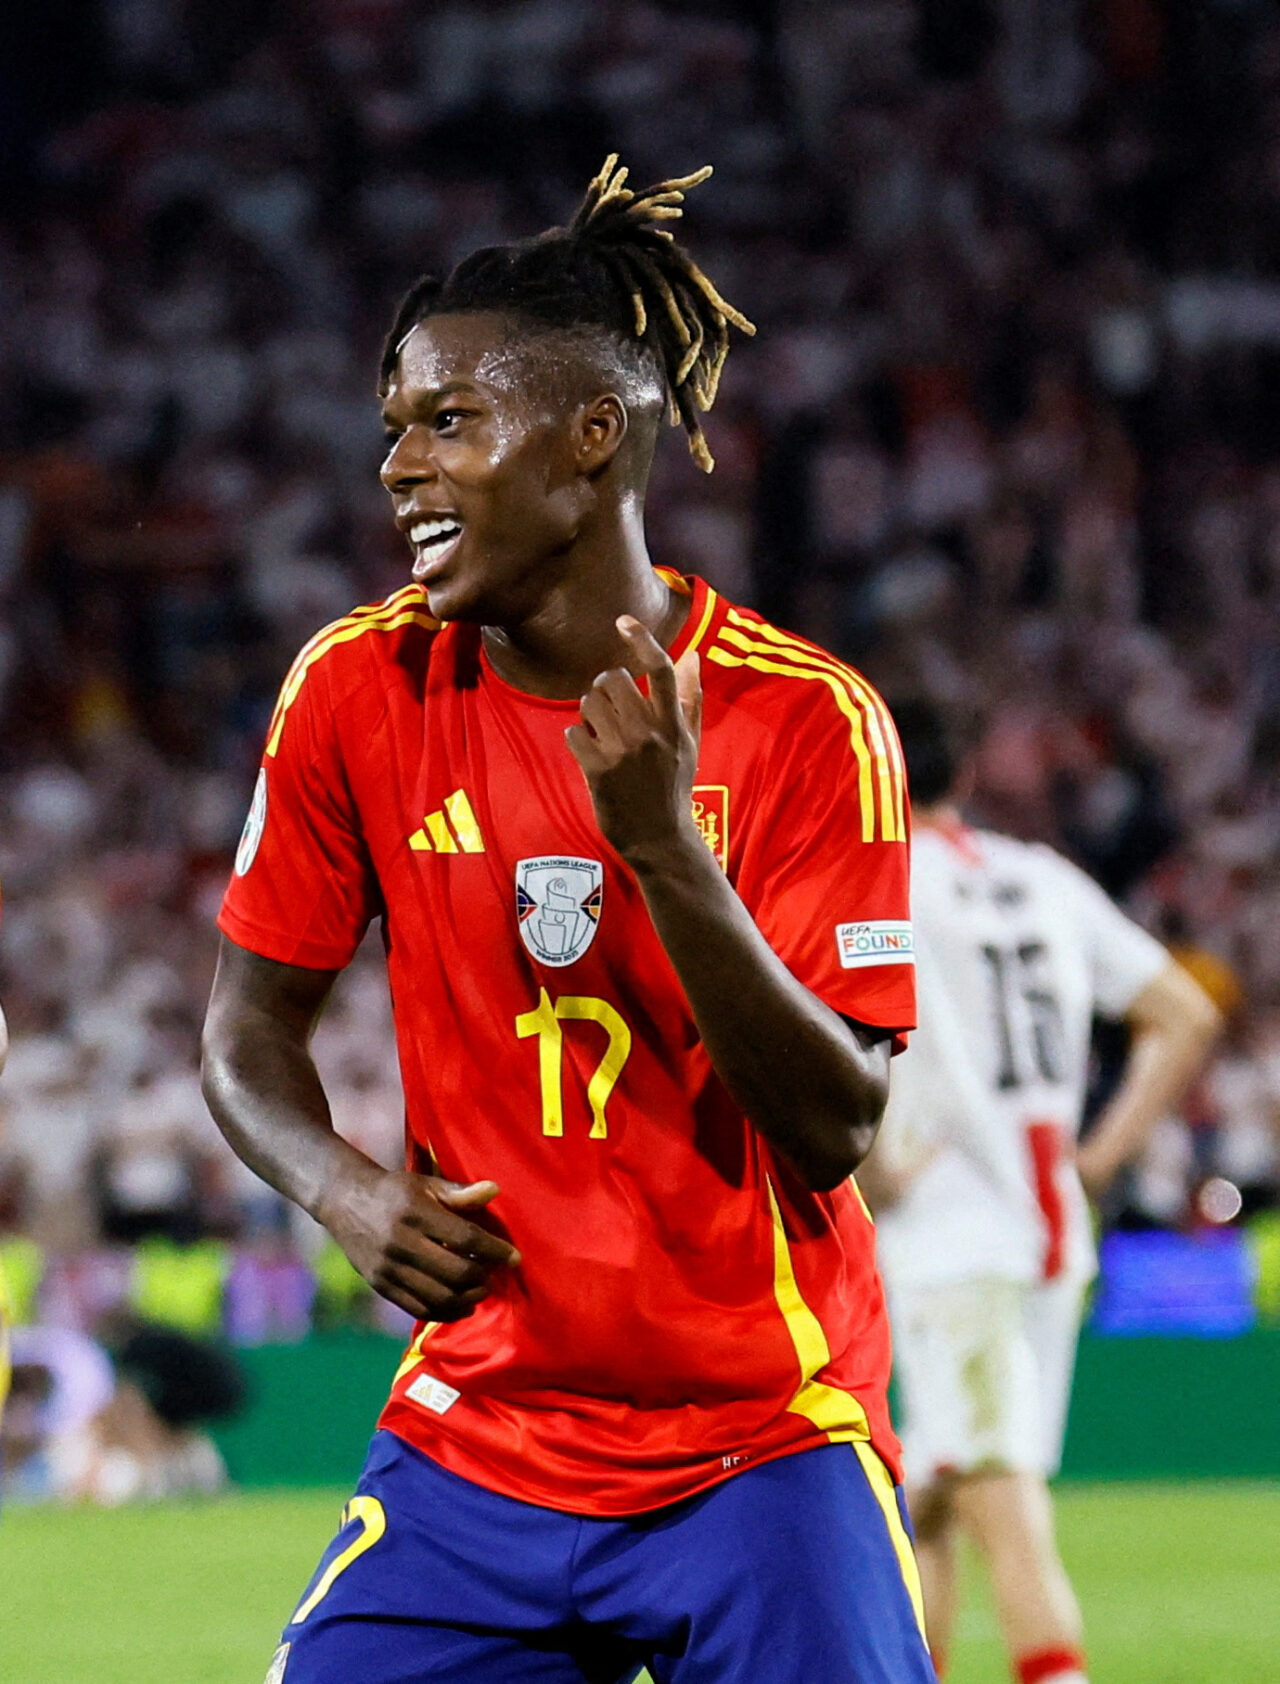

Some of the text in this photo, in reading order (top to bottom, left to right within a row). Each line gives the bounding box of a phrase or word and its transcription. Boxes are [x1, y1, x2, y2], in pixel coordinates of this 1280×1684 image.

[522, 862, 538, 870] UEFA
[571, 861, 598, 870] LEAGUE
[841, 926, 871, 936] UEFA
[843, 935, 914, 952] FOUND
[981, 938, 1062, 1089] 15
[515, 986, 632, 1139] 17
[291, 1495, 388, 1624] 7
